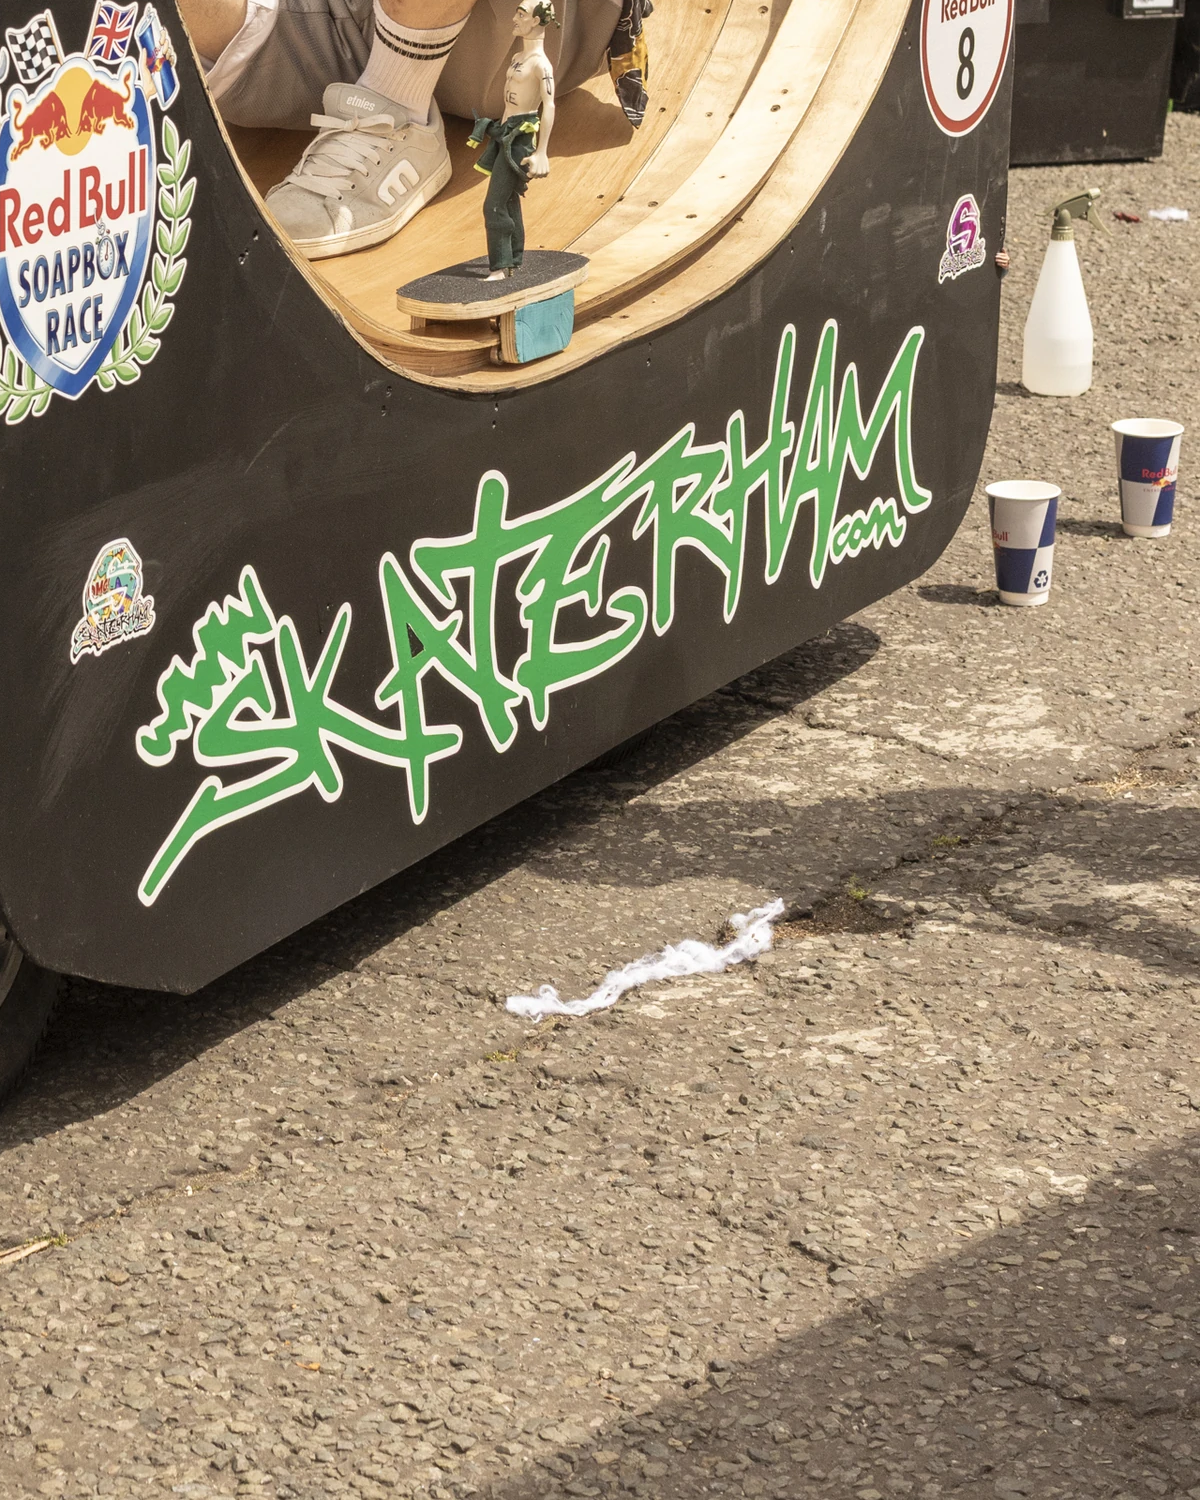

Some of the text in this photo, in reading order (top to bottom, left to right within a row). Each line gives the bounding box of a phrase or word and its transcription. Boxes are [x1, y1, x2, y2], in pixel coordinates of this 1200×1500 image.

[956, 26, 975, 100] 8
[346, 95, 376, 111] etnies
[78, 148, 146, 229] Bull
[17, 229, 131, 308] SOAPBOX
[46, 295, 104, 357] RACE
[1141, 467, 1163, 479] Red
[136, 318, 933, 907] SKATERHAM
